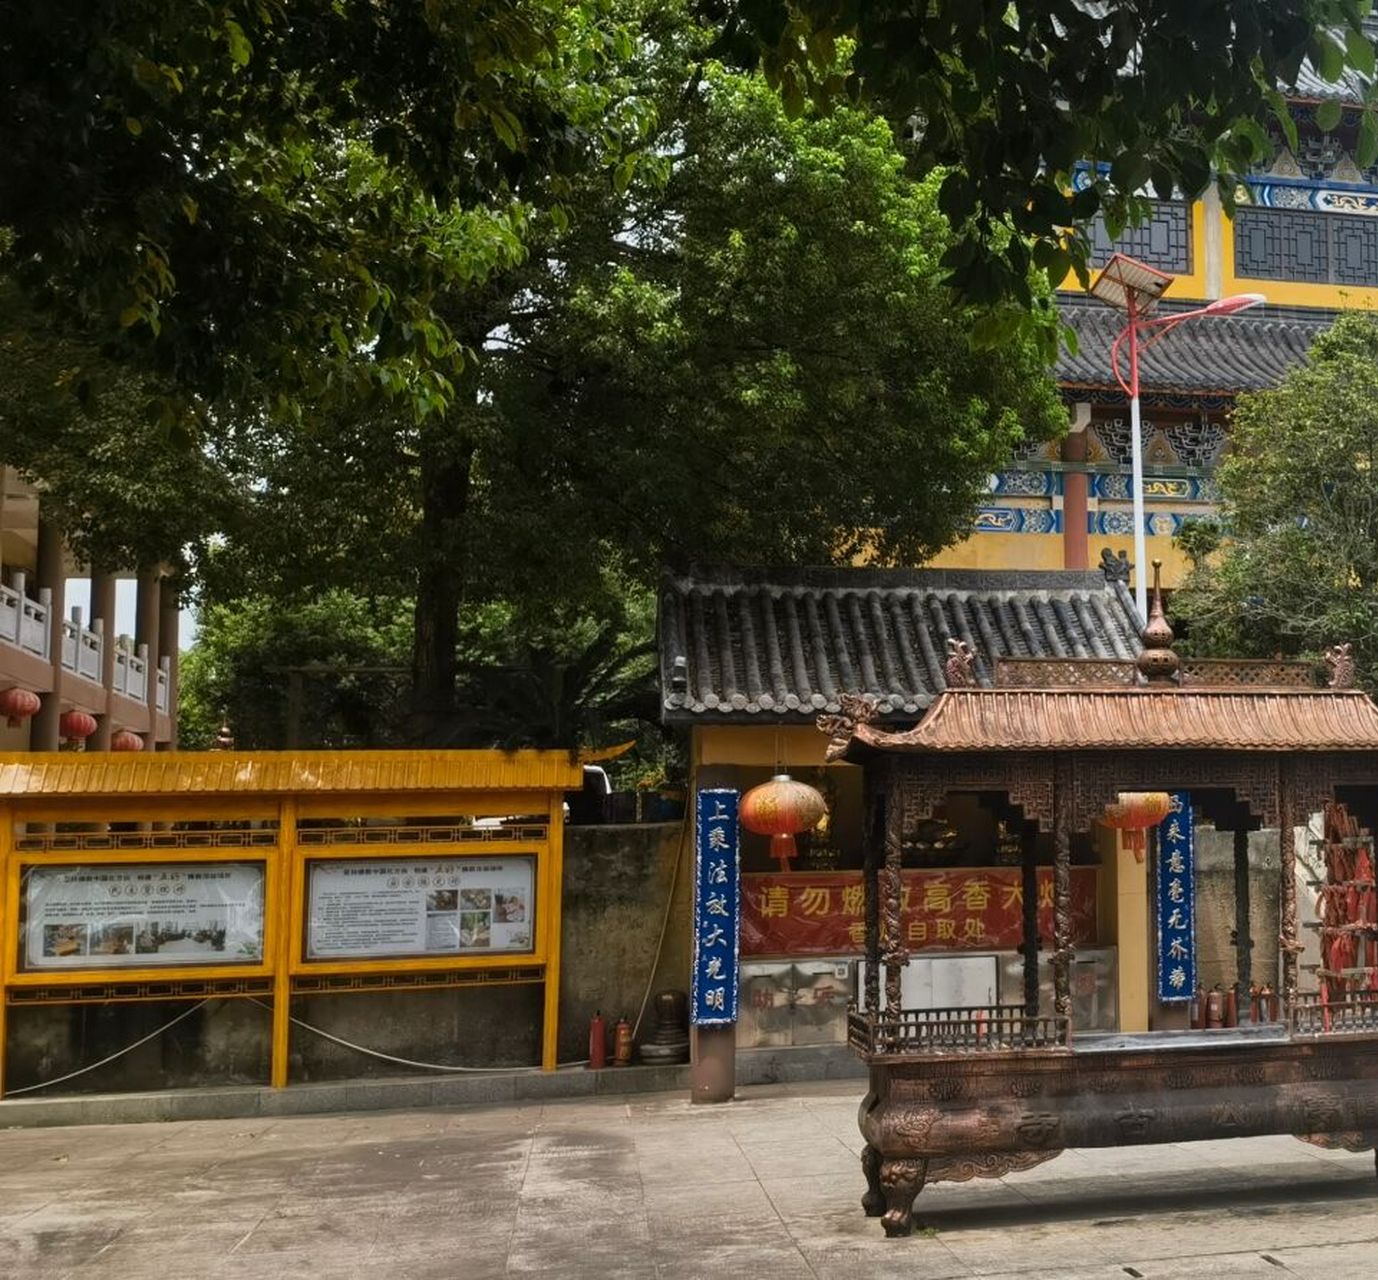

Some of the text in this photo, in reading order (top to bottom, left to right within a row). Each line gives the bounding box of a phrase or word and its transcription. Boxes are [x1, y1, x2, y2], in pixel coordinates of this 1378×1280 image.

[702, 800, 731, 1012] 上乘法放大光明
[848, 917, 986, 943] 香自取处
